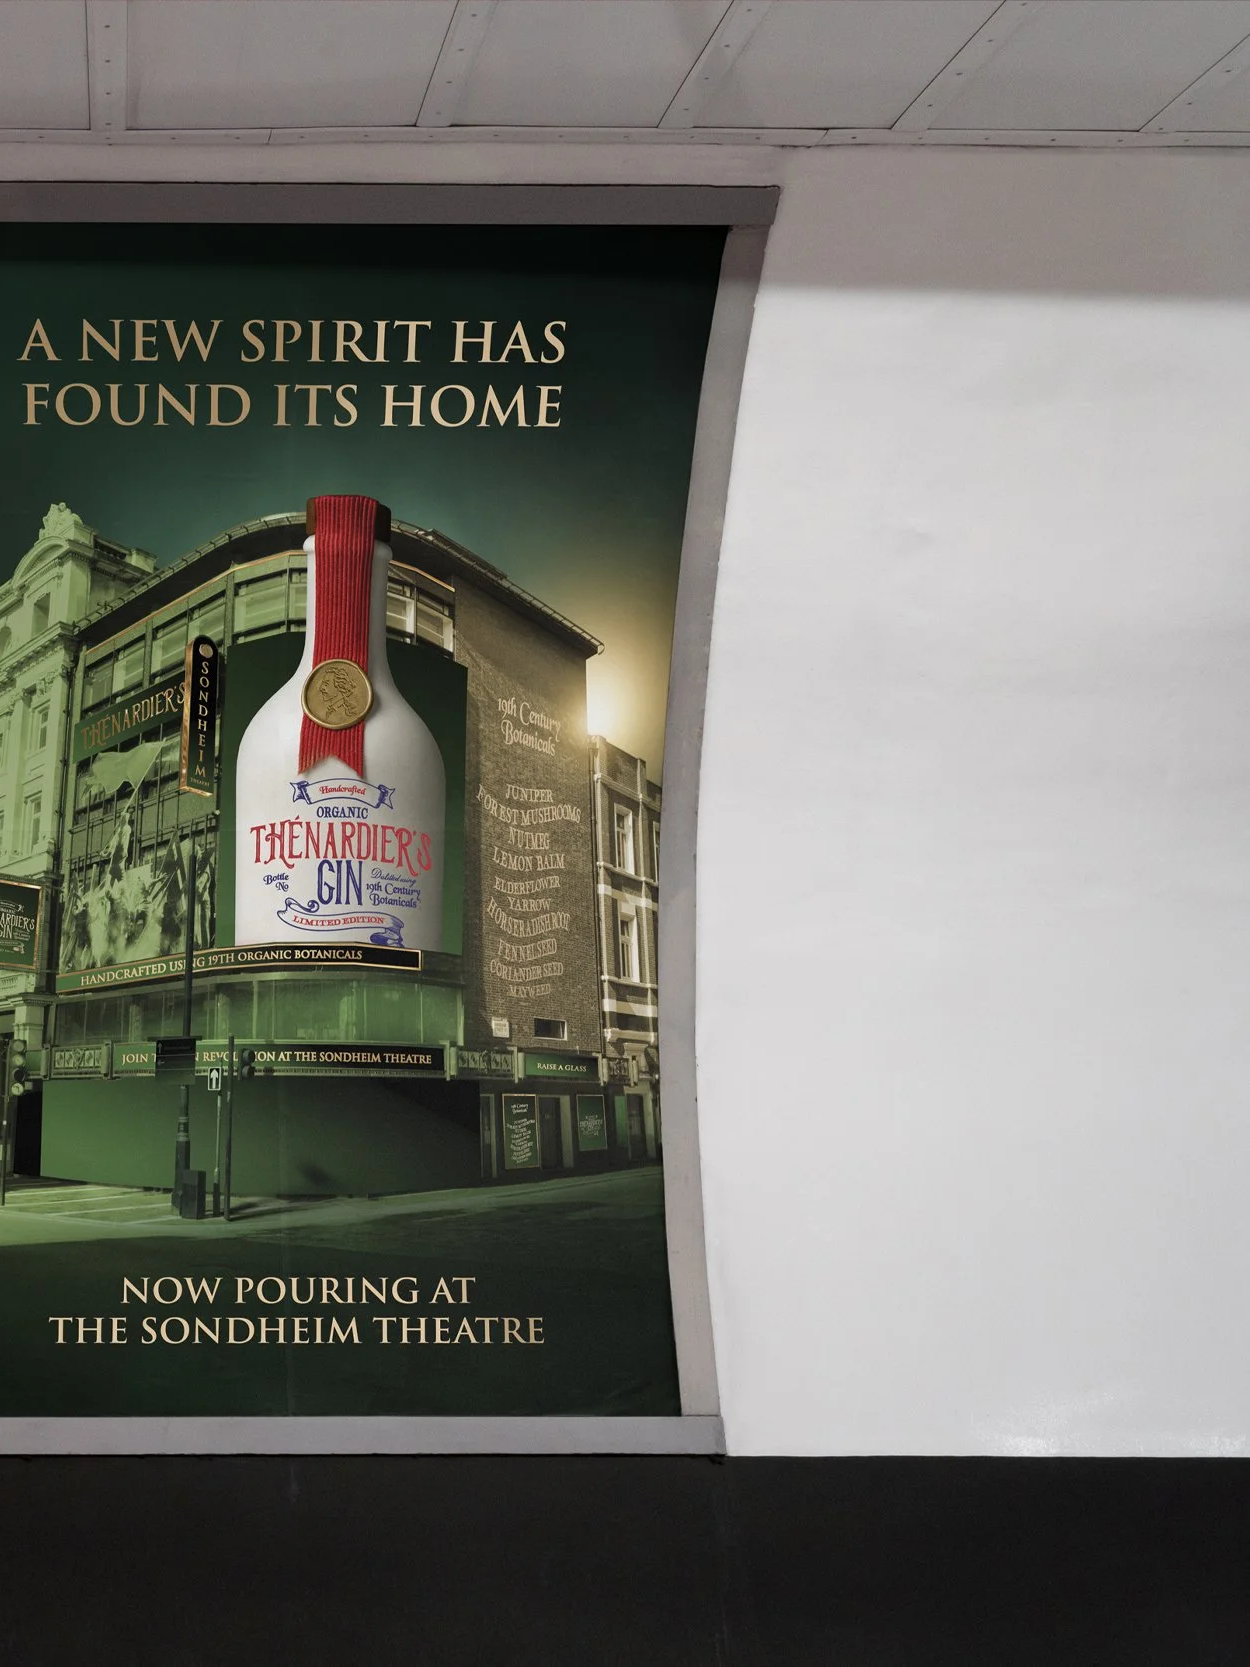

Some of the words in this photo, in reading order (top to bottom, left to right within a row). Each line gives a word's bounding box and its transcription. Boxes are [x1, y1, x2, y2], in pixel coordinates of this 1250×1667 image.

[16, 318, 63, 361] A
[78, 318, 224, 363] NEW
[241, 319, 432, 363] SPIRIT
[450, 320, 567, 364] HAS
[22, 382, 251, 426] FOUND
[273, 384, 359, 427] ITS
[380, 384, 562, 428] HOME
[194, 661, 210, 778] SONDHEIM
[497, 697, 517, 719] 19th
[519, 701, 561, 743] Century
[500, 719, 556, 757] Botanicals
[319, 785, 367, 796] Handcrafted
[505, 783, 553, 802] JUNIPER
[316, 806, 369, 819] ORGANIC
[476, 784, 519, 825] FOREST
[520, 804, 581, 826] MUSHROOMS
[250, 815, 434, 877] THÉNARDIER'S
[507, 826, 550, 850] NUTMEG
[492, 845, 533, 872] LEMON
[536, 853, 565, 871] BALM
[263, 872, 289, 886] Bottle
[275, 881, 290, 893] No
[316, 859, 364, 906] GIN
[493, 875, 561, 895] ELDERFLOWER
[366, 881, 383, 893] 19th
[384, 882, 421, 903] Century
[369, 893, 418, 908] Botanicals
[507, 896, 551, 912] YARROW
[293, 915, 341, 927] LIMITED
[342, 916, 386, 926] EDITION
[498, 938, 535, 962] FENNEL
[536, 938, 557, 955] SEED
[80, 963, 166, 986] HANDCRAFTED
[208, 951, 235, 967] 19TH
[237, 950, 292, 962] ORGANIC
[294, 949, 363, 960] BOTANICALS
[490, 959, 543, 982] CORIANDER
[543, 961, 564, 976] SEED
[508, 983, 551, 998] MAYWEED
[121, 1053, 150, 1065] JOIN
[278, 1051, 292, 1062] AT
[292, 1051, 317, 1062] THE
[319, 1052, 382, 1063] SONDHEIM
[383, 1053, 432, 1064] THEATRE
[537, 1062, 557, 1071] RAISE
[557, 1063, 564, 1071] A
[565, 1064, 587, 1072] GLASS
[120, 1276, 223, 1304] NOW
[234, 1276, 420, 1305] POURING
[428, 1276, 476, 1304] AT
[48, 1316, 127, 1344] THE
[141, 1316, 363, 1344] SONDHEIM
[372, 1316, 545, 1344] THEATRE
